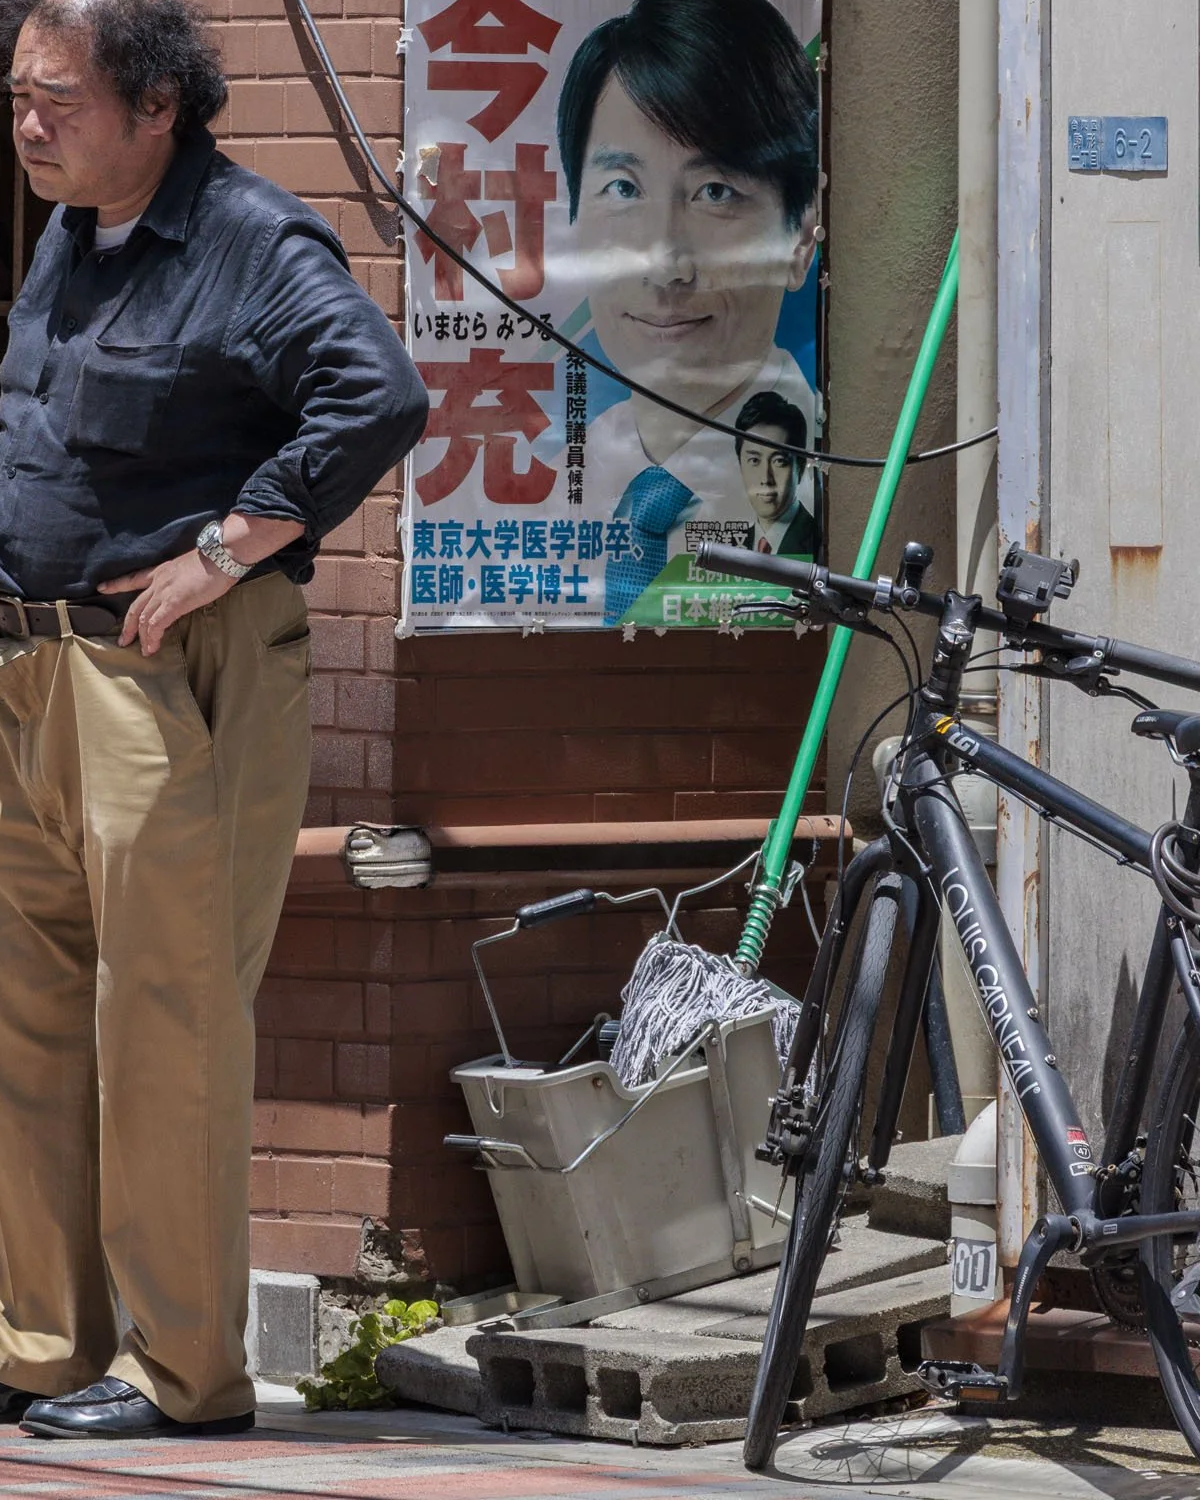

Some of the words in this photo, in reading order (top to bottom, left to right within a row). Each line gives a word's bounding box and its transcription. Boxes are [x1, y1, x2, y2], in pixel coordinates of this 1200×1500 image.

[1114, 127, 1152, 159] 6-2
[413, 311, 488, 342] いまむら
[496, 312, 555, 342] みつる
[415, 347, 558, 509] 充
[410, 564, 589, 606] 医師・医学博士
[941, 866, 988, 965] LOUIS
